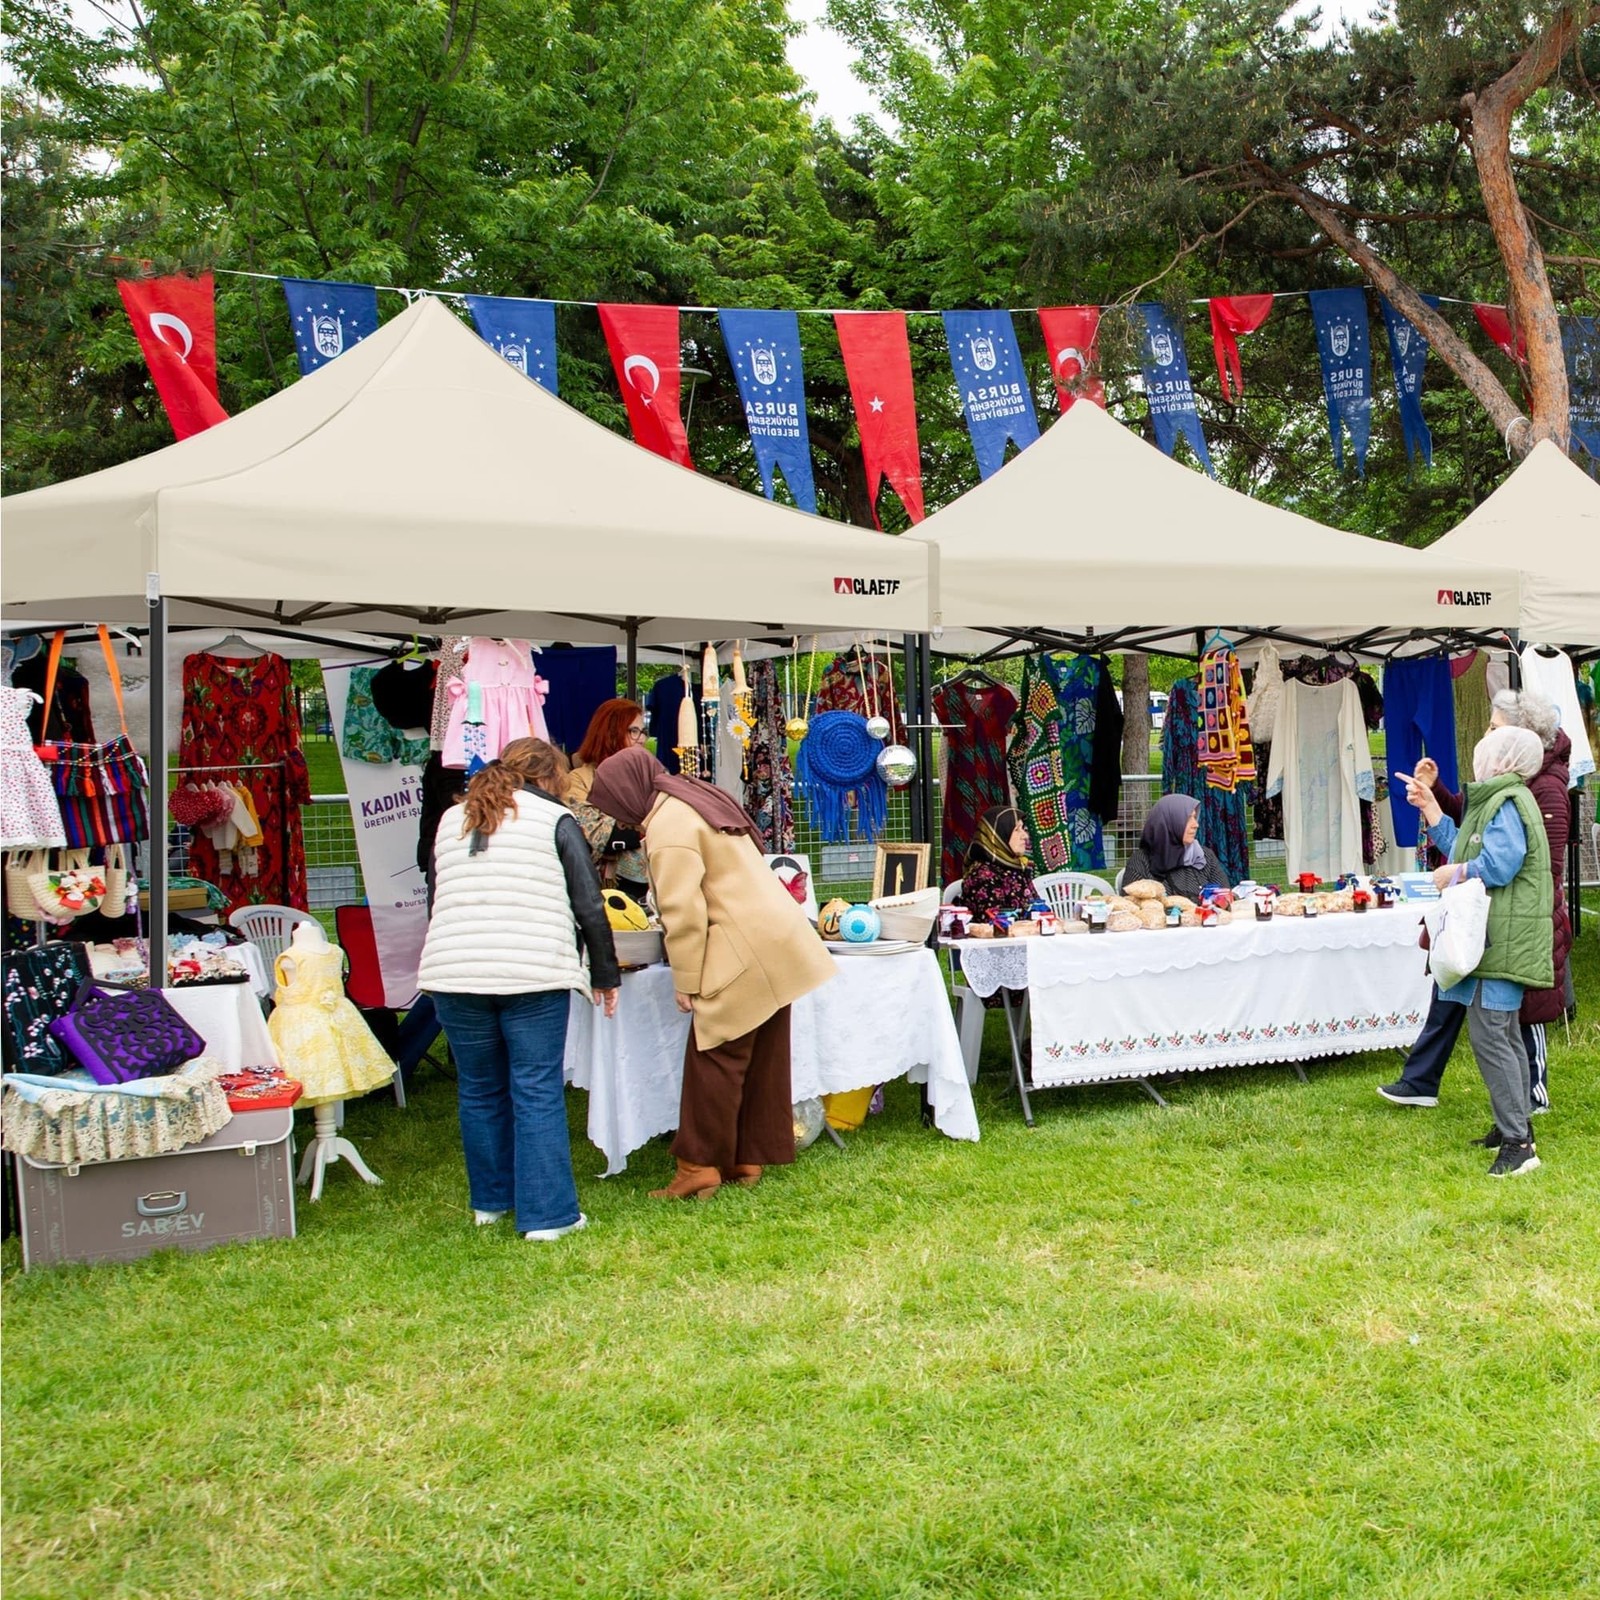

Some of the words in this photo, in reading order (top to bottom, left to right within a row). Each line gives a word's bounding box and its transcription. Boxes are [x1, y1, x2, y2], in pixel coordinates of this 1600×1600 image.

[853, 578, 900, 595] CLAETF
[1453, 591, 1492, 606] CLAETF
[361, 789, 412, 817] KADIN
[364, 814, 396, 829] ÜRETİM
[396, 810, 407, 820] VE
